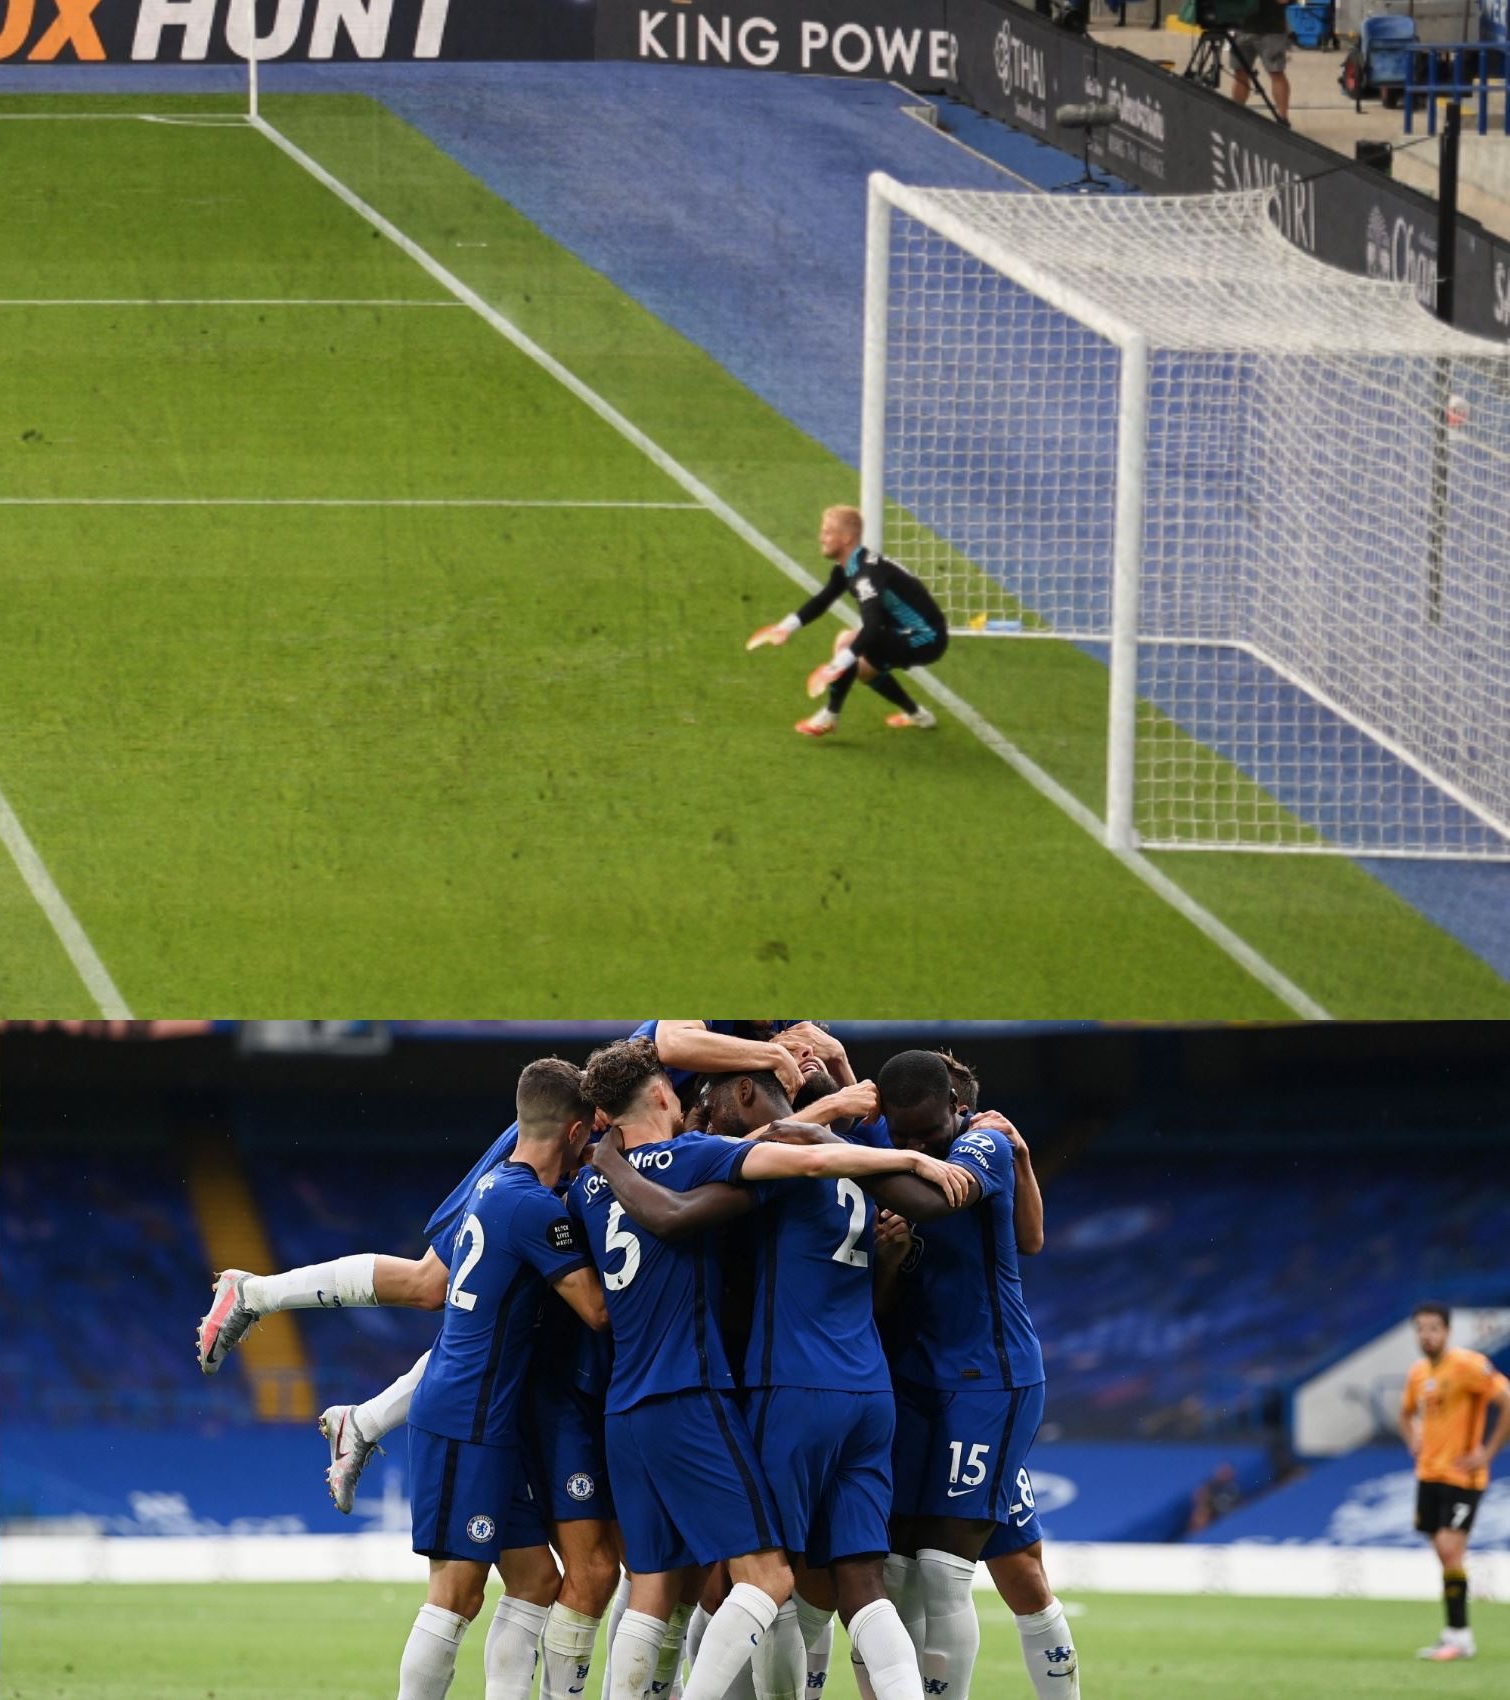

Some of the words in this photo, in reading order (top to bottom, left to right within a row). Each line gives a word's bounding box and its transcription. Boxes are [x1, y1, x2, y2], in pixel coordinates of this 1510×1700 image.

[130, 0, 450, 61] HUNT
[638, 9, 780, 66] KING
[800, 21, 959, 83] POWER
[1010, 36, 1046, 100] THAI
[603, 1201, 641, 1291] 5
[949, 1440, 990, 1486] 15
[1009, 1467, 1035, 1515] 8
